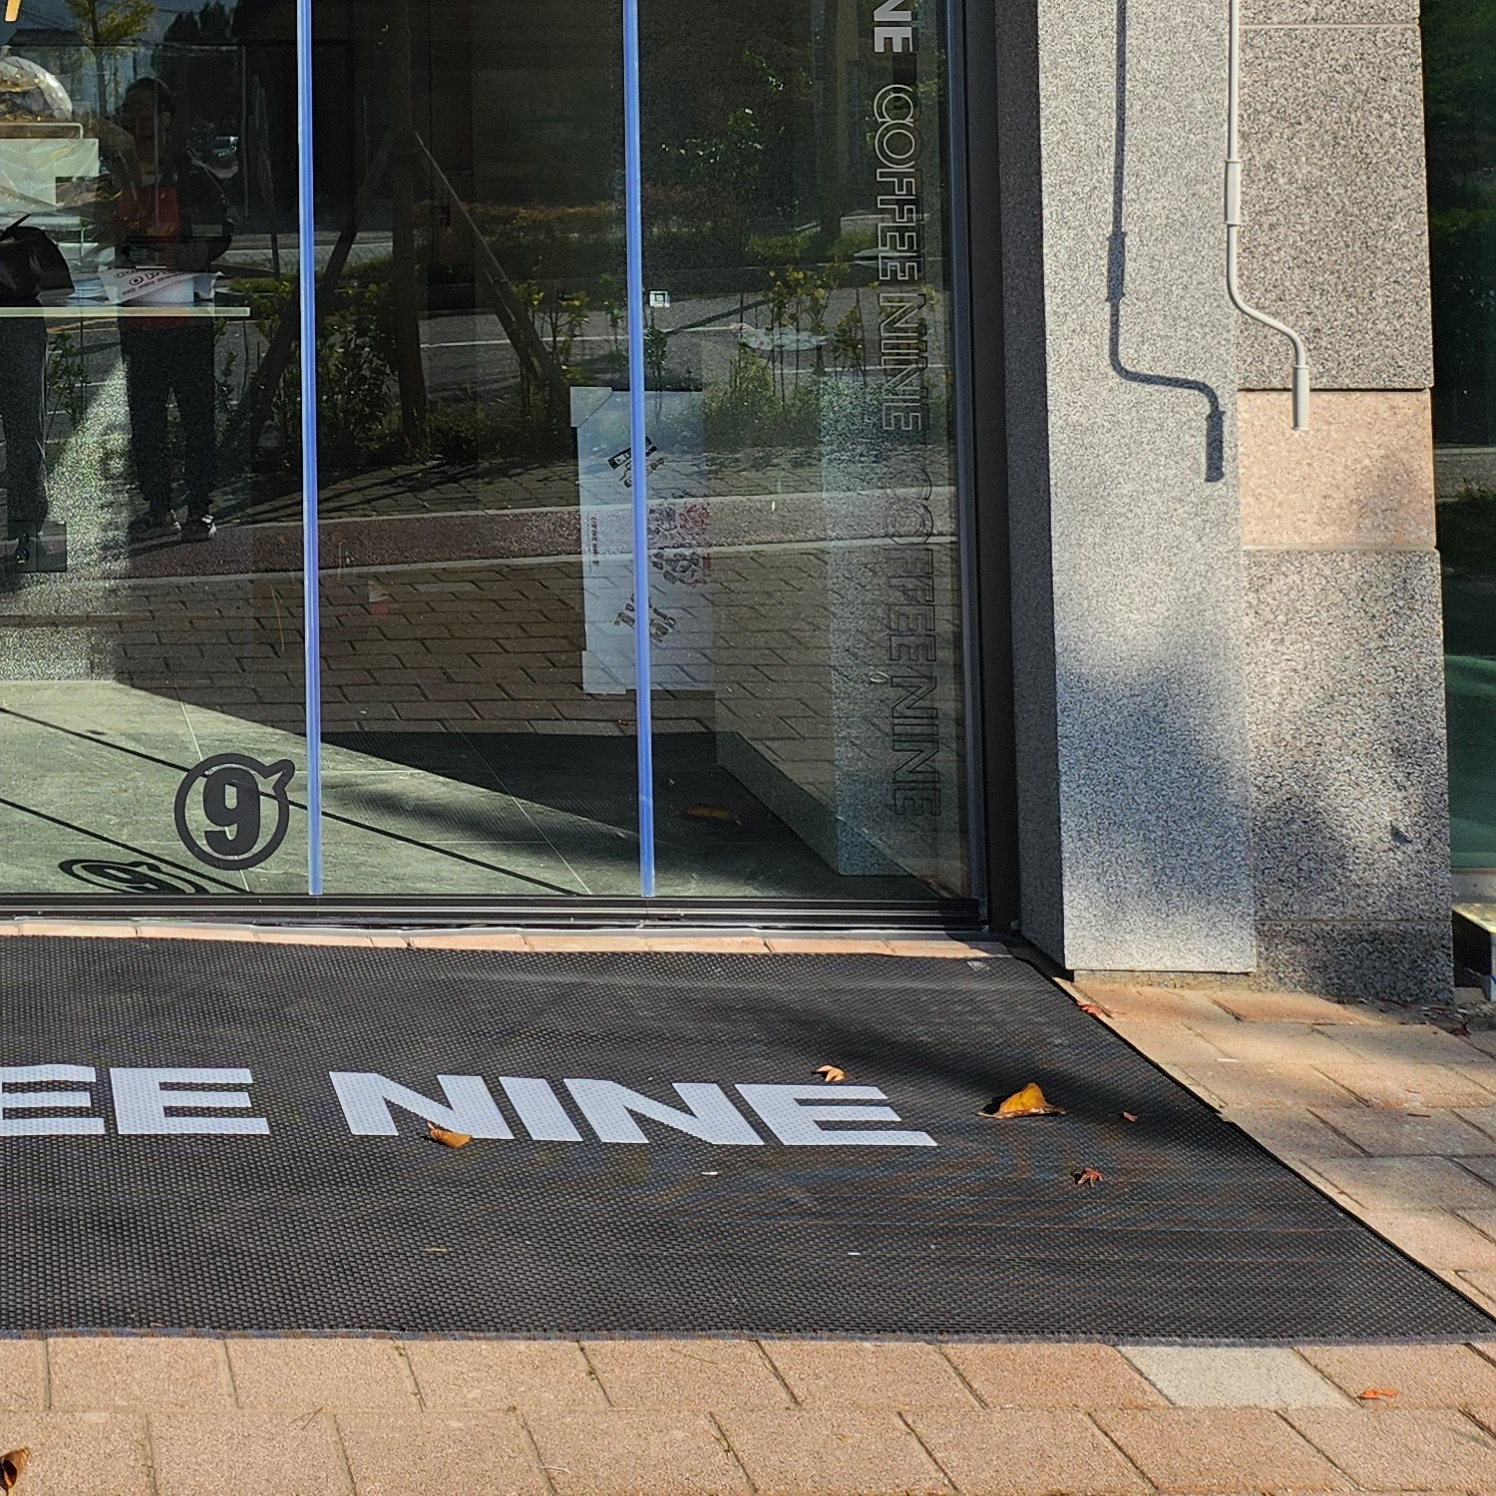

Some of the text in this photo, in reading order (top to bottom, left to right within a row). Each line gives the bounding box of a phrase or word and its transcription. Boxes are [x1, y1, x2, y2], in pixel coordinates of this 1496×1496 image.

[873, 84, 922, 431] COFFEE NINE
[889, 676, 942, 816] NINE
[329, 1070, 939, 1147] NINE
